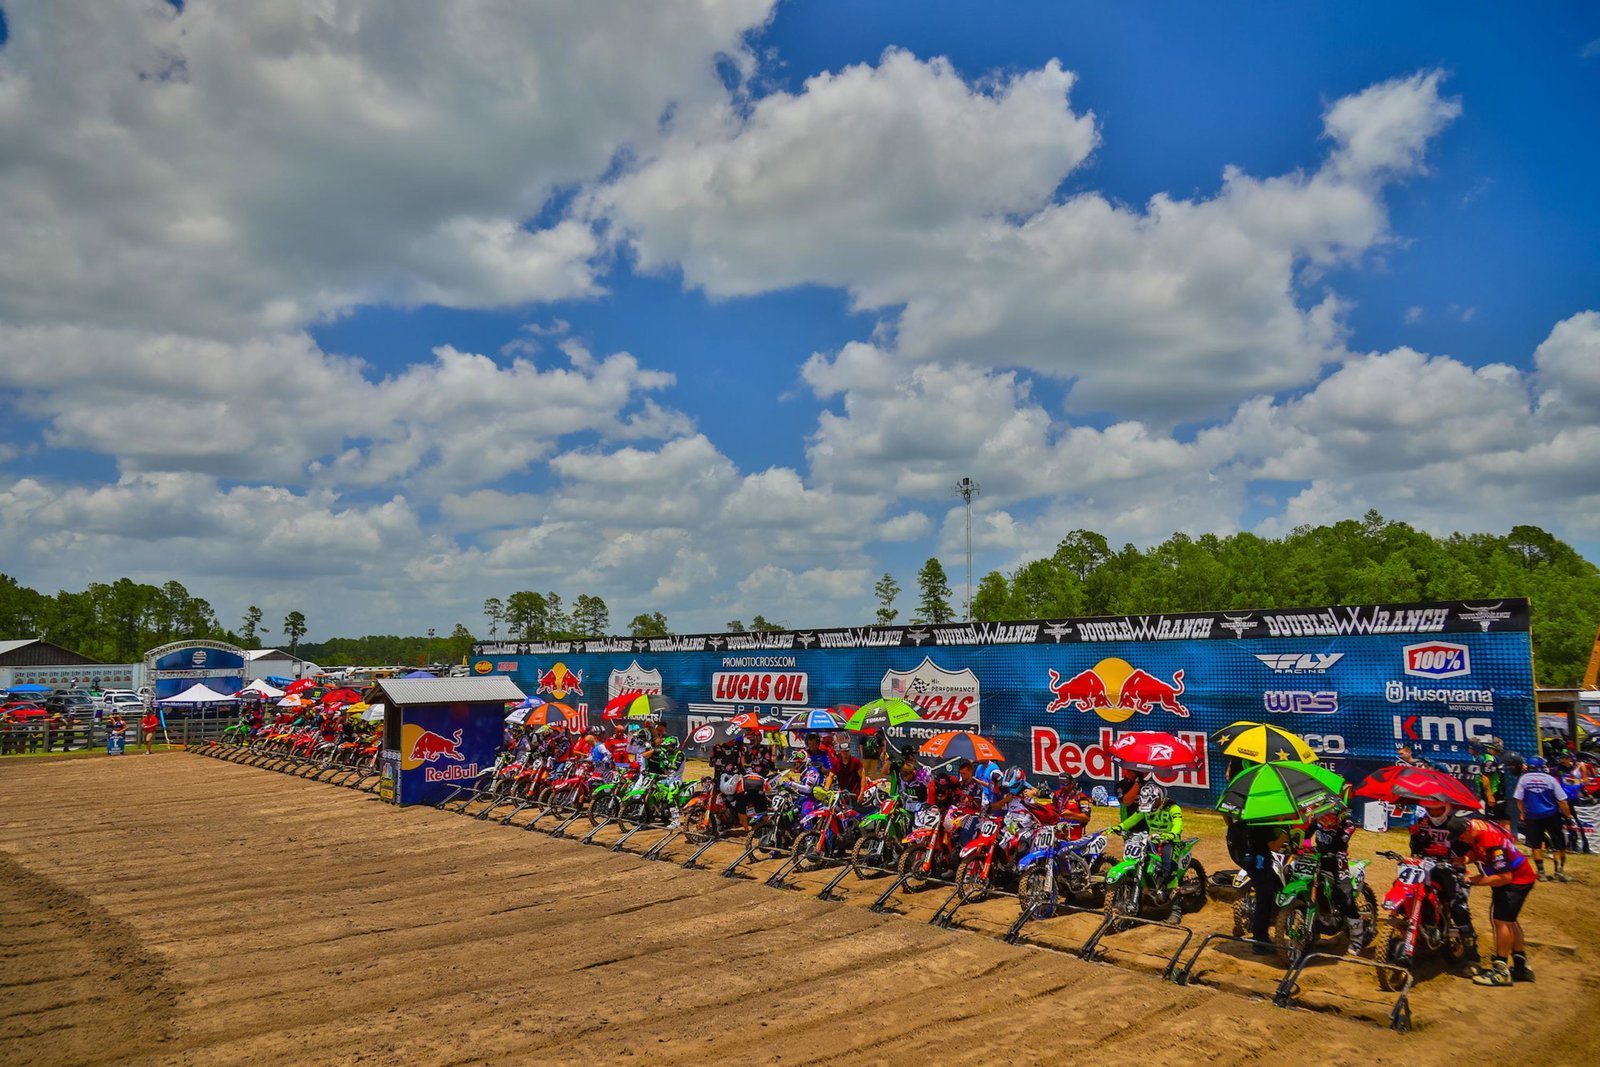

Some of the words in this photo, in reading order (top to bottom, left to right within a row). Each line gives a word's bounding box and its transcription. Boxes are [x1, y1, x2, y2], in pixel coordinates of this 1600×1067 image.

[722, 656, 796, 668] PROMOTOCROSS.COM
[1272, 652, 1344, 669] FLY
[1413, 650, 1461, 670] 100%
[716, 674, 772, 701] LUCAS
[774, 674, 805, 702] OIL
[1405, 686, 1494, 704] Husqvarna
[738, 705, 779, 716] PRO
[904, 695, 974, 721] UCAS
[1264, 691, 1339, 713] WPS
[887, 727, 906, 738] OIL
[910, 728, 975, 739] PROD
[1032, 727, 1113, 778] Red
[425, 766, 451, 782] Red
[453, 763, 478, 780] Bull
[882, 801, 890, 811] 1
[925, 815, 936, 827] 2
[1092, 837, 1107, 853] 700
[1124, 844, 1142, 859] 80
